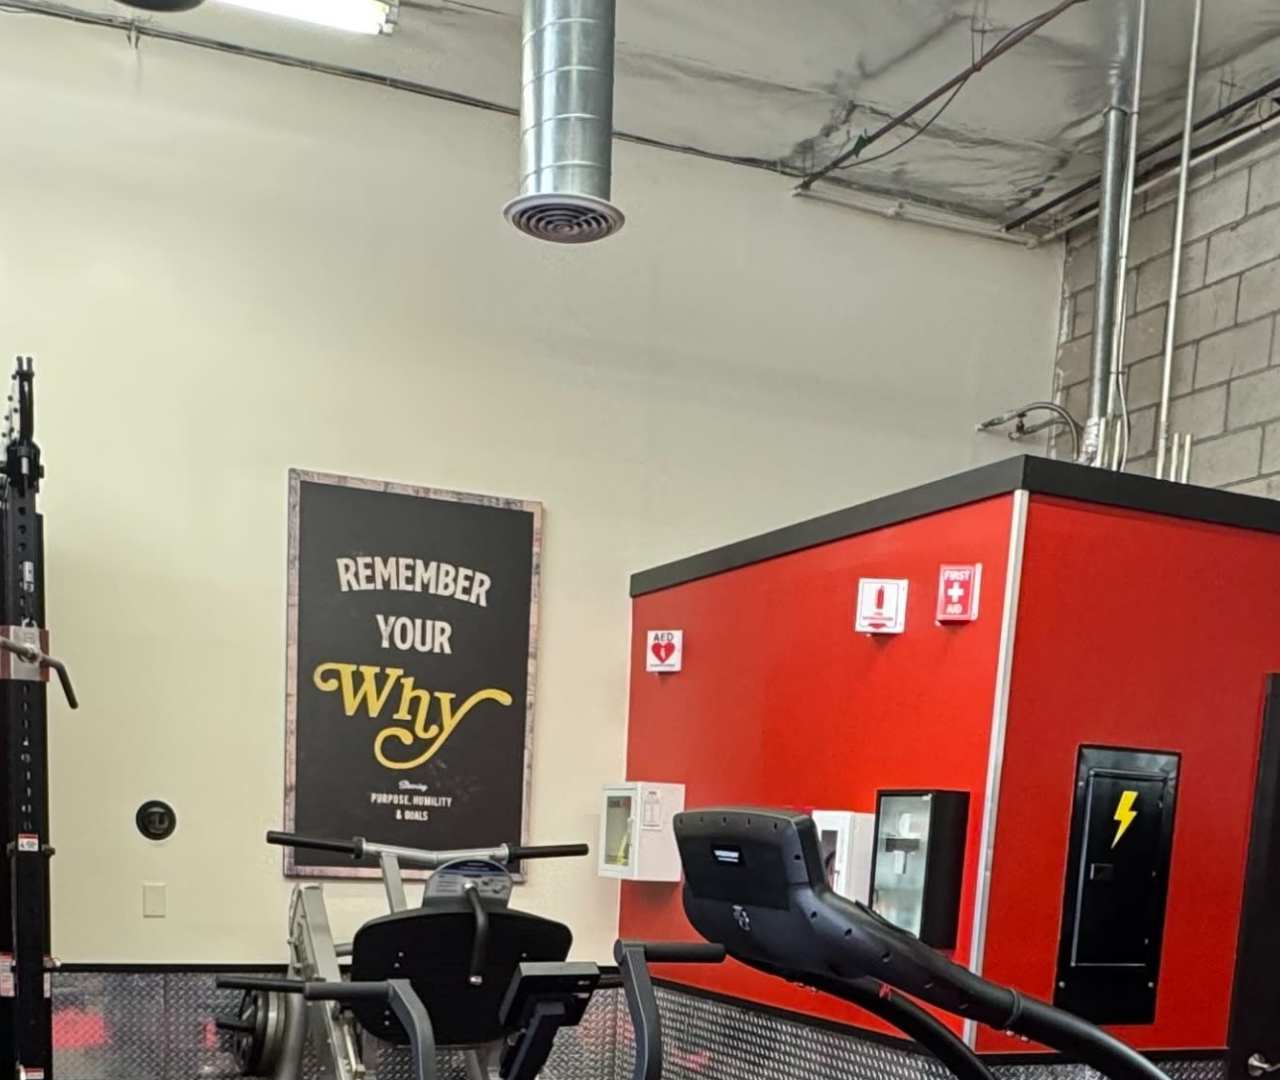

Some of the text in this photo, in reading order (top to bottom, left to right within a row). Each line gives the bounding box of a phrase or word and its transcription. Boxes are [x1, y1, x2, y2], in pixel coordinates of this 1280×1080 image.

[943, 569, 971, 581] FIRST
[336, 556, 491, 607] REMEMBER
[946, 603, 963, 615] AID
[376, 614, 452, 654] YOUR
[653, 632, 674, 642] AED
[313, 662, 513, 770] Why
[413, 796, 452, 808] HUMILITY
